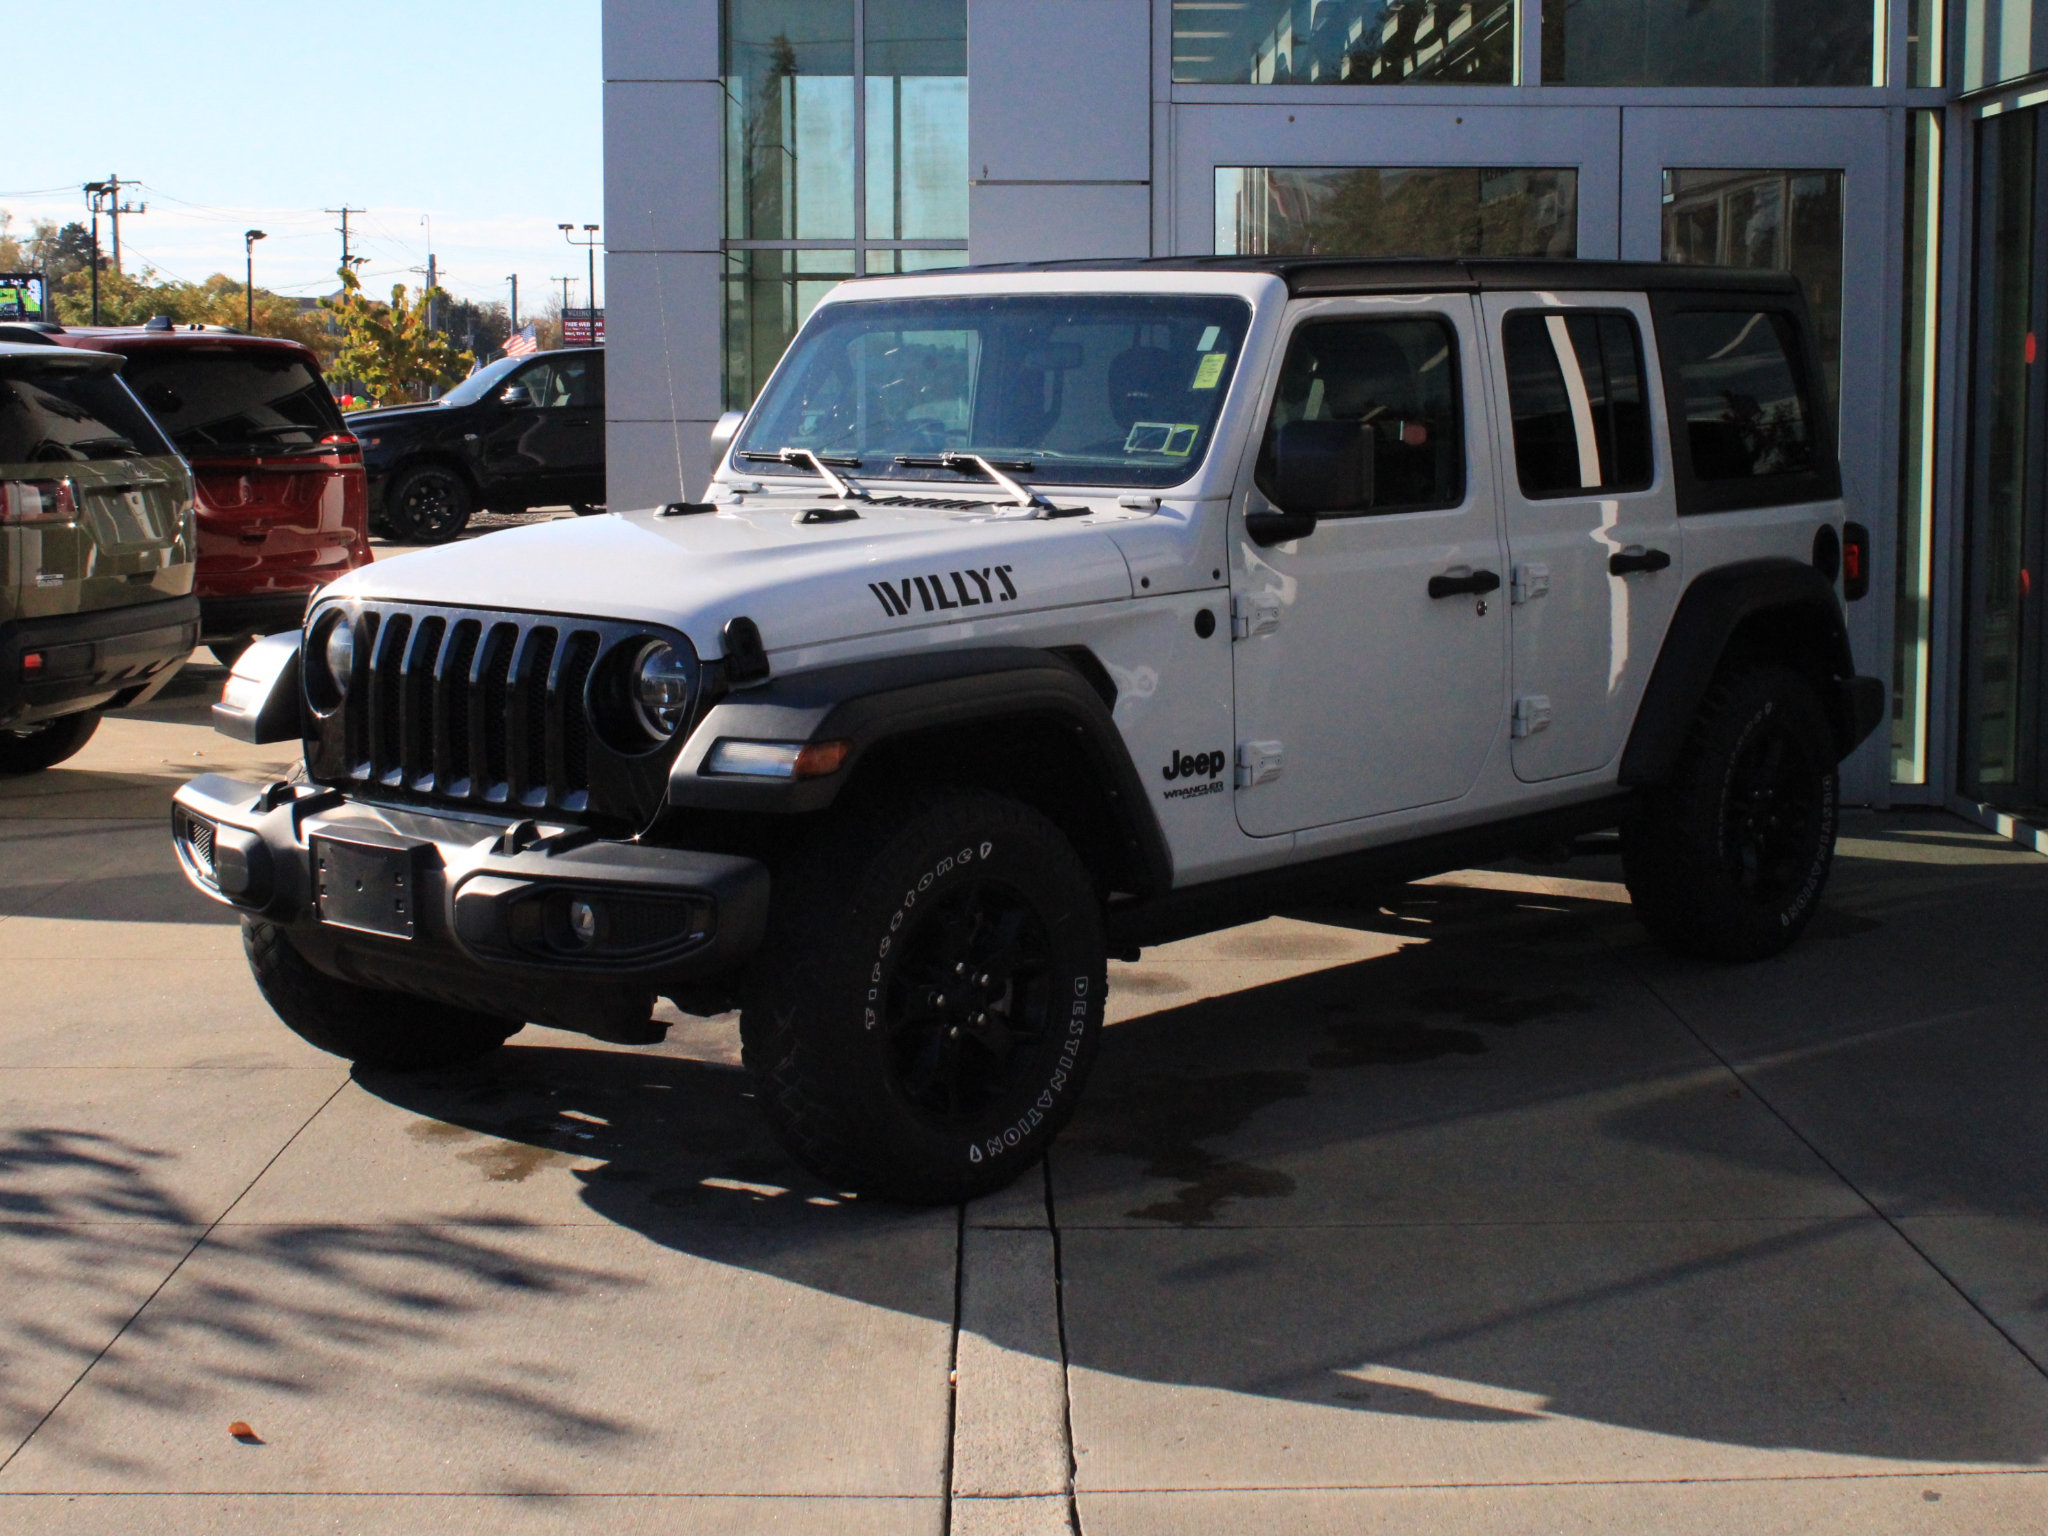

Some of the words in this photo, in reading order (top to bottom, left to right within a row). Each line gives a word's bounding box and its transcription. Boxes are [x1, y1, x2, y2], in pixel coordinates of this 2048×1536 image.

[868, 564, 1018, 617] WILLYS
[1162, 749, 1226, 781] Jeep
[1163, 781, 1224, 799] WRANGLER
[985, 975, 1089, 1158] DESTINATION
